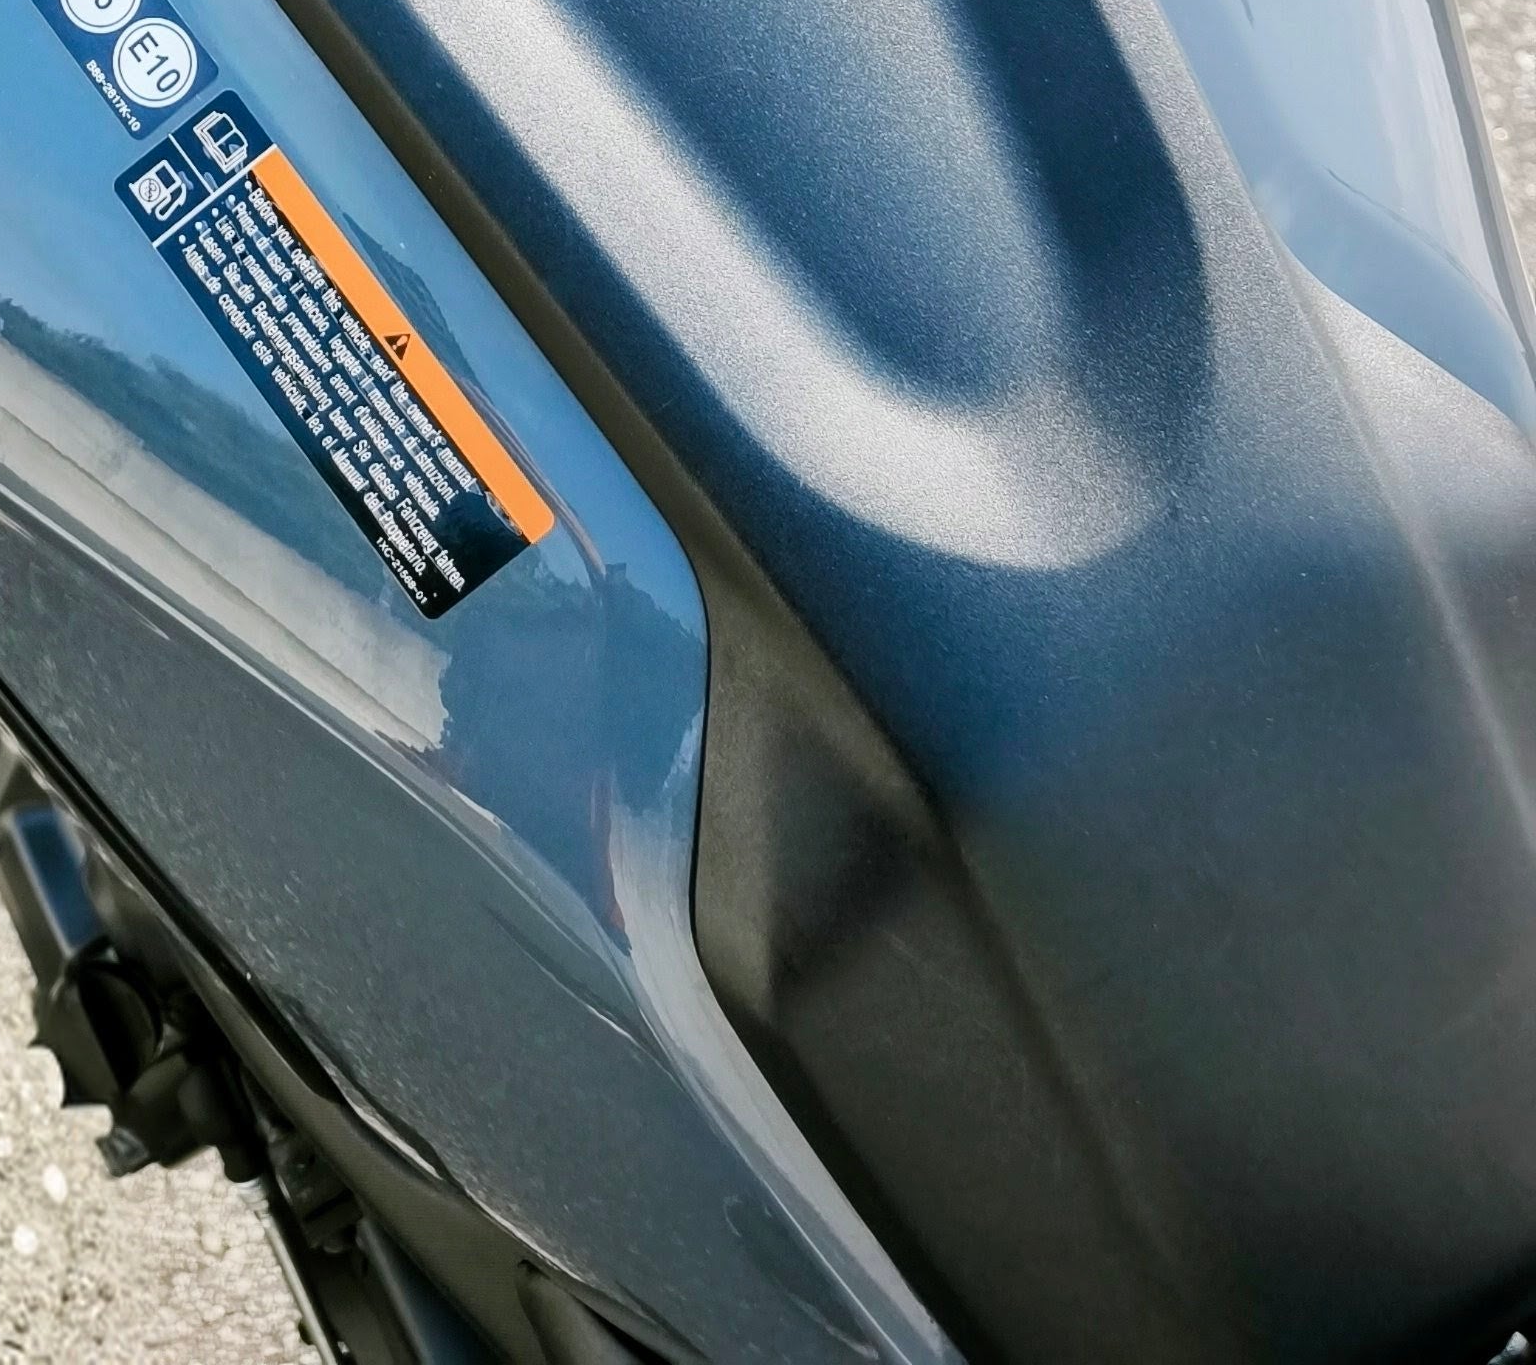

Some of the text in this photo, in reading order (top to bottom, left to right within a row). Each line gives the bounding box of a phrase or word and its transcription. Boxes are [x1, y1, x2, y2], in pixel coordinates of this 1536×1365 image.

[128, 31, 180, 92] E10
[182, 243, 208, 277] Antes
[204, 276, 220, 293] de
[218, 294, 255, 338] conducir
[252, 340, 273, 365] este
[306, 412, 323, 435] lea
[322, 435, 337, 449] el
[331, 447, 368, 491] Manual
[363, 492, 384, 512] del
[376, 510, 425, 575] Propietario.
[198, 228, 464, 591] Lesen Sie die Bedienungsanleitung bevor Sie dieses Fahrzeug fahren.
[215, 215, 439, 520] Lire le manuel du propriétaire avant d'utiliser ce véhicule.
[232, 201, 258, 236] Prima
[255, 236, 271, 251] di
[265, 250, 292, 282] usare
[289, 280, 303, 293] il
[298, 293, 329, 336] veicolo,
[328, 333, 363, 376] leggete
[359, 374, 373, 387] il
[368, 388, 405, 436] manuale
[248, 188, 277, 225] Before
[271, 225, 293, 248] you
[290, 248, 325, 289] operate
[321, 288, 341, 311] this
[369, 354, 396, 381] read
[390, 380, 408, 404] the
[406, 404, 444, 446] owner's
